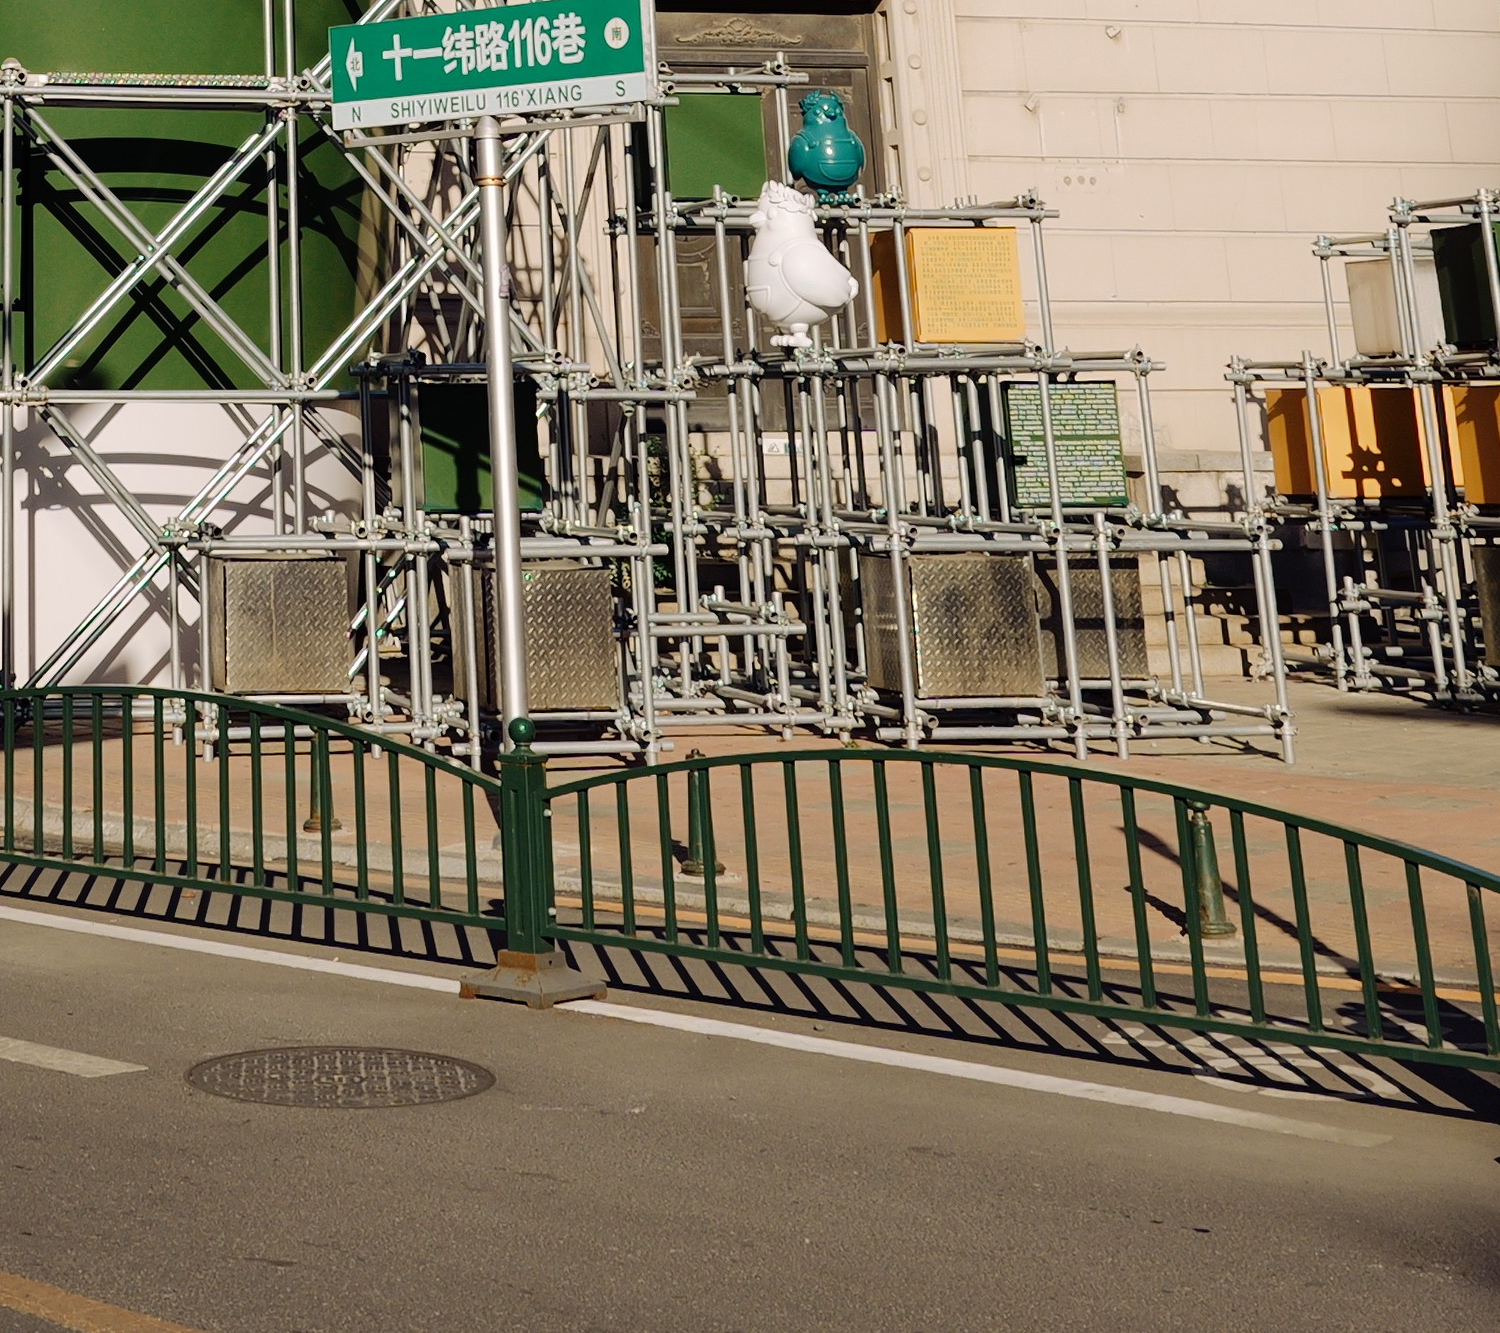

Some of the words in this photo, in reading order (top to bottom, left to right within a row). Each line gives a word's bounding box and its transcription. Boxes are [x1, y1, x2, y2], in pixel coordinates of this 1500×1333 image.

[382, 13, 586, 81] 十一纬路116巷
[351, 107, 362, 123] N
[390, 94, 487, 119] SHIYIWEILU
[615, 80, 626, 97] S
